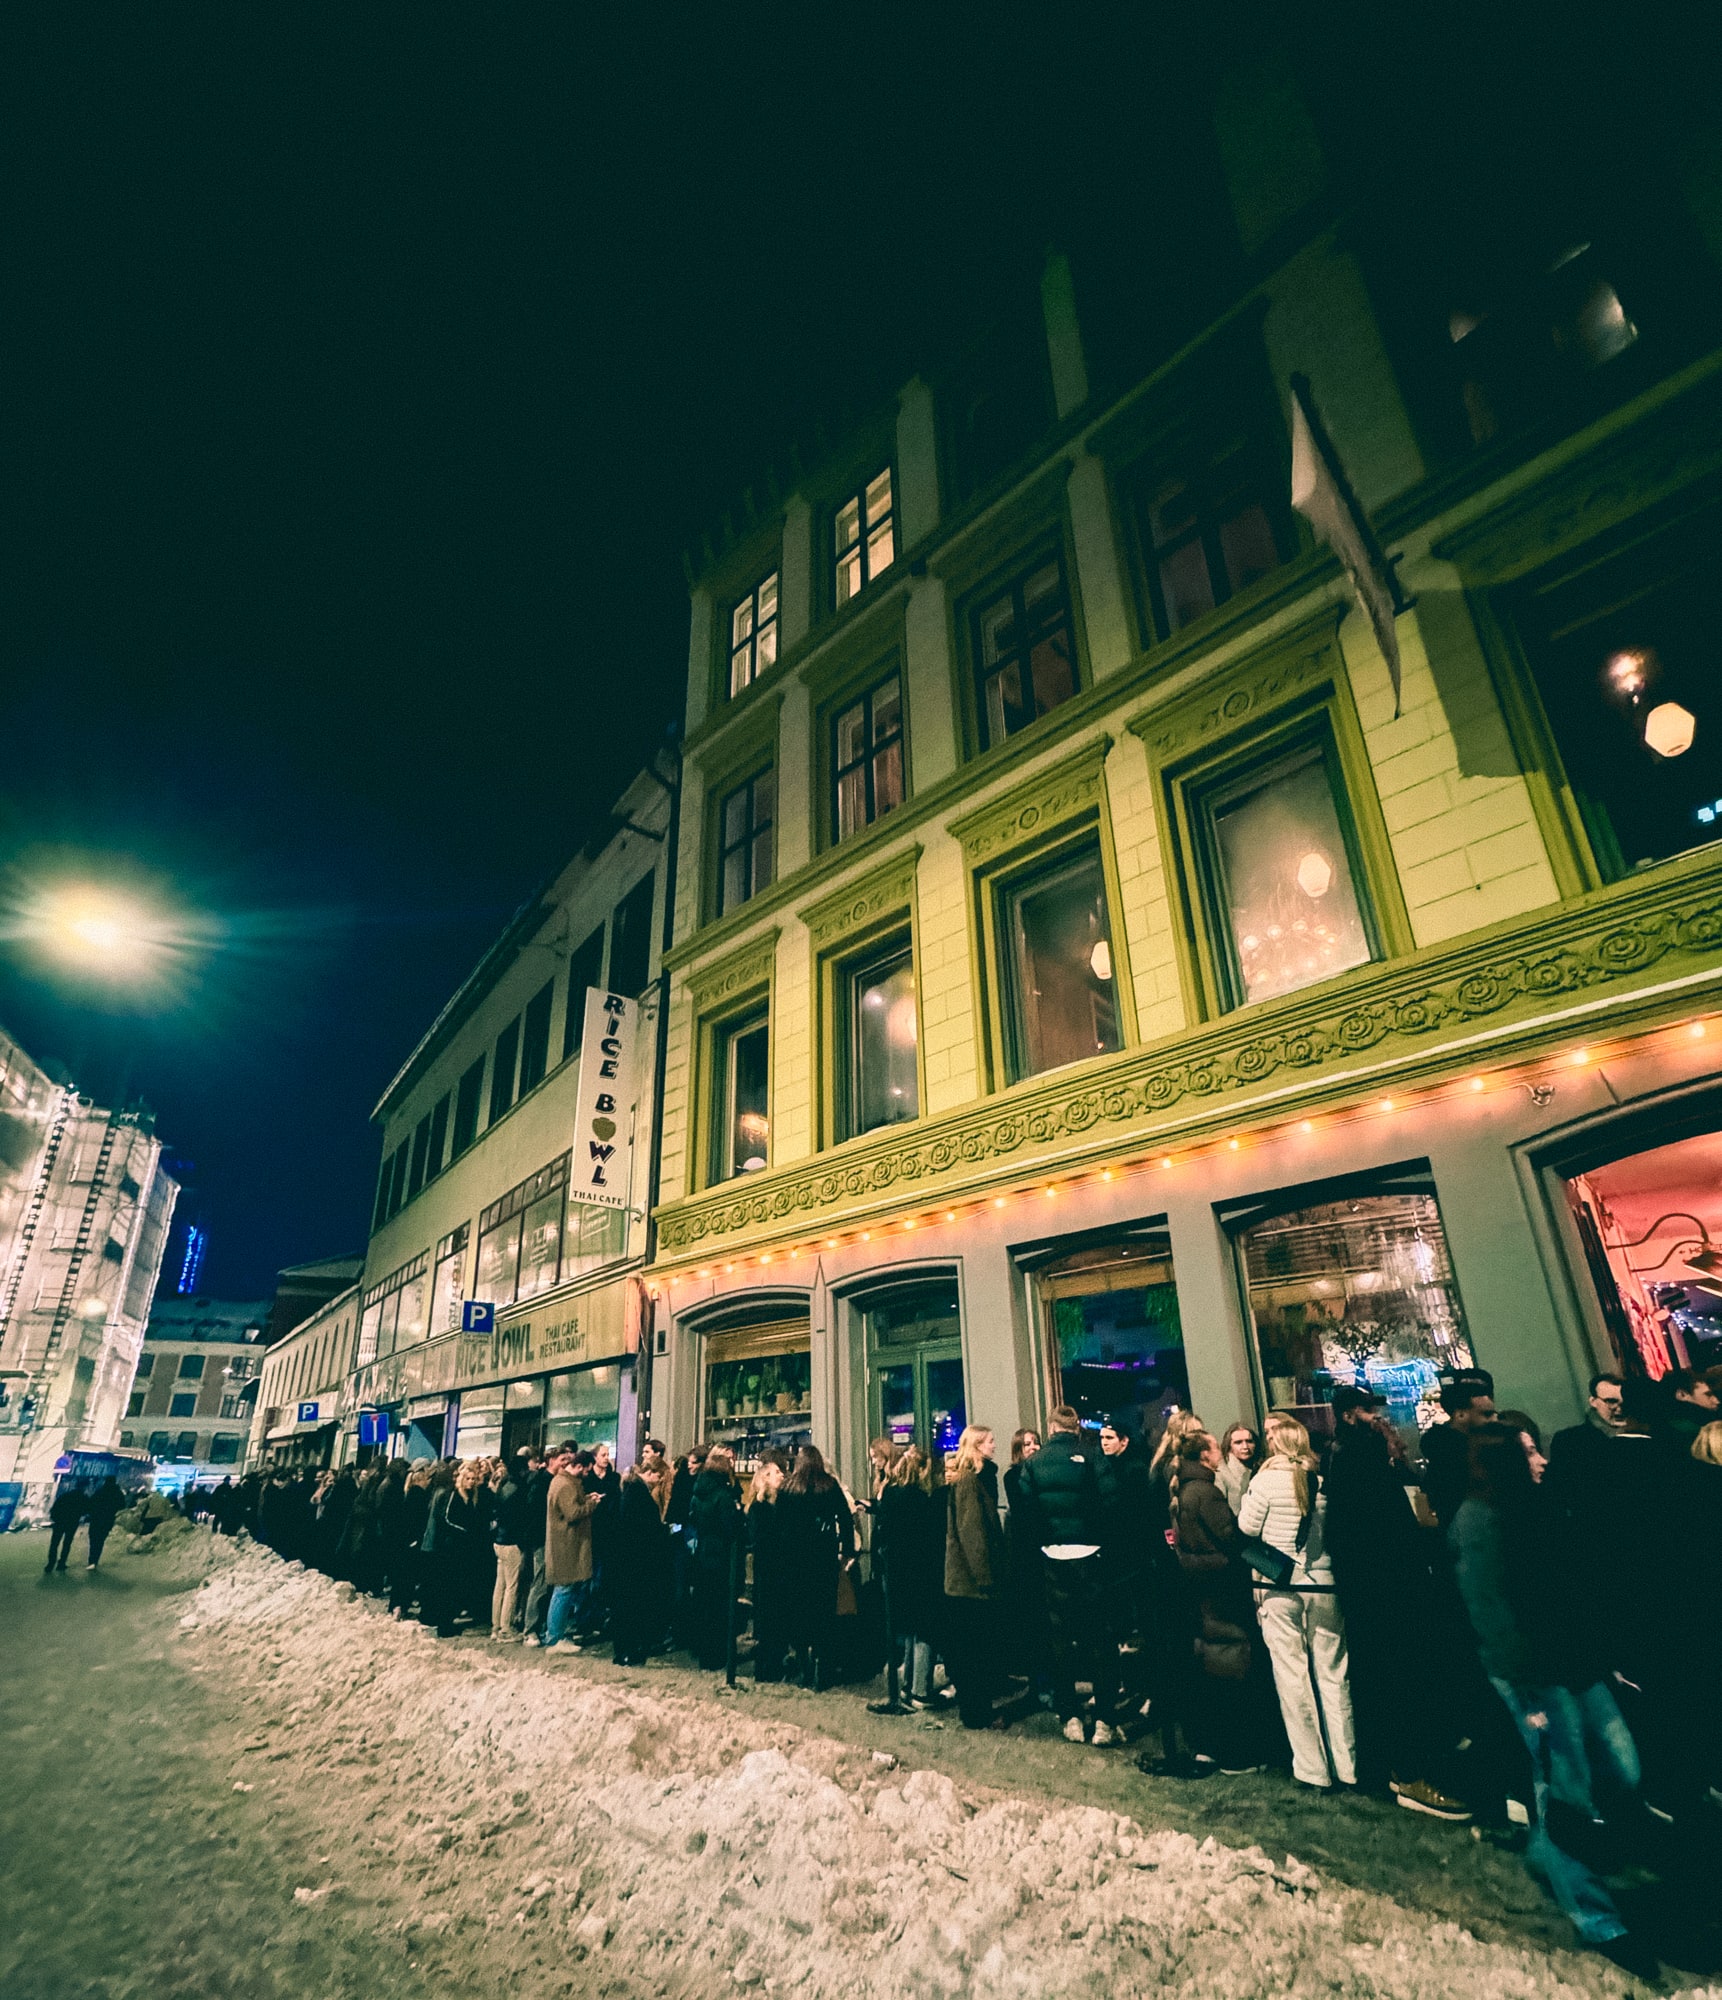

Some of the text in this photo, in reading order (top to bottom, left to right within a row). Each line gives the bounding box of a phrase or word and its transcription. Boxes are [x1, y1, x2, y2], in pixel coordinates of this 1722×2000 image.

[600, 994, 625, 1079] RICE
[573, 1190, 597, 1201] THAI
[469, 1305, 487, 1328] P
[545, 1324, 561, 1341] THAI
[539, 1333, 586, 1359] RESTAURANT
[302, 1405, 314, 1420] P
